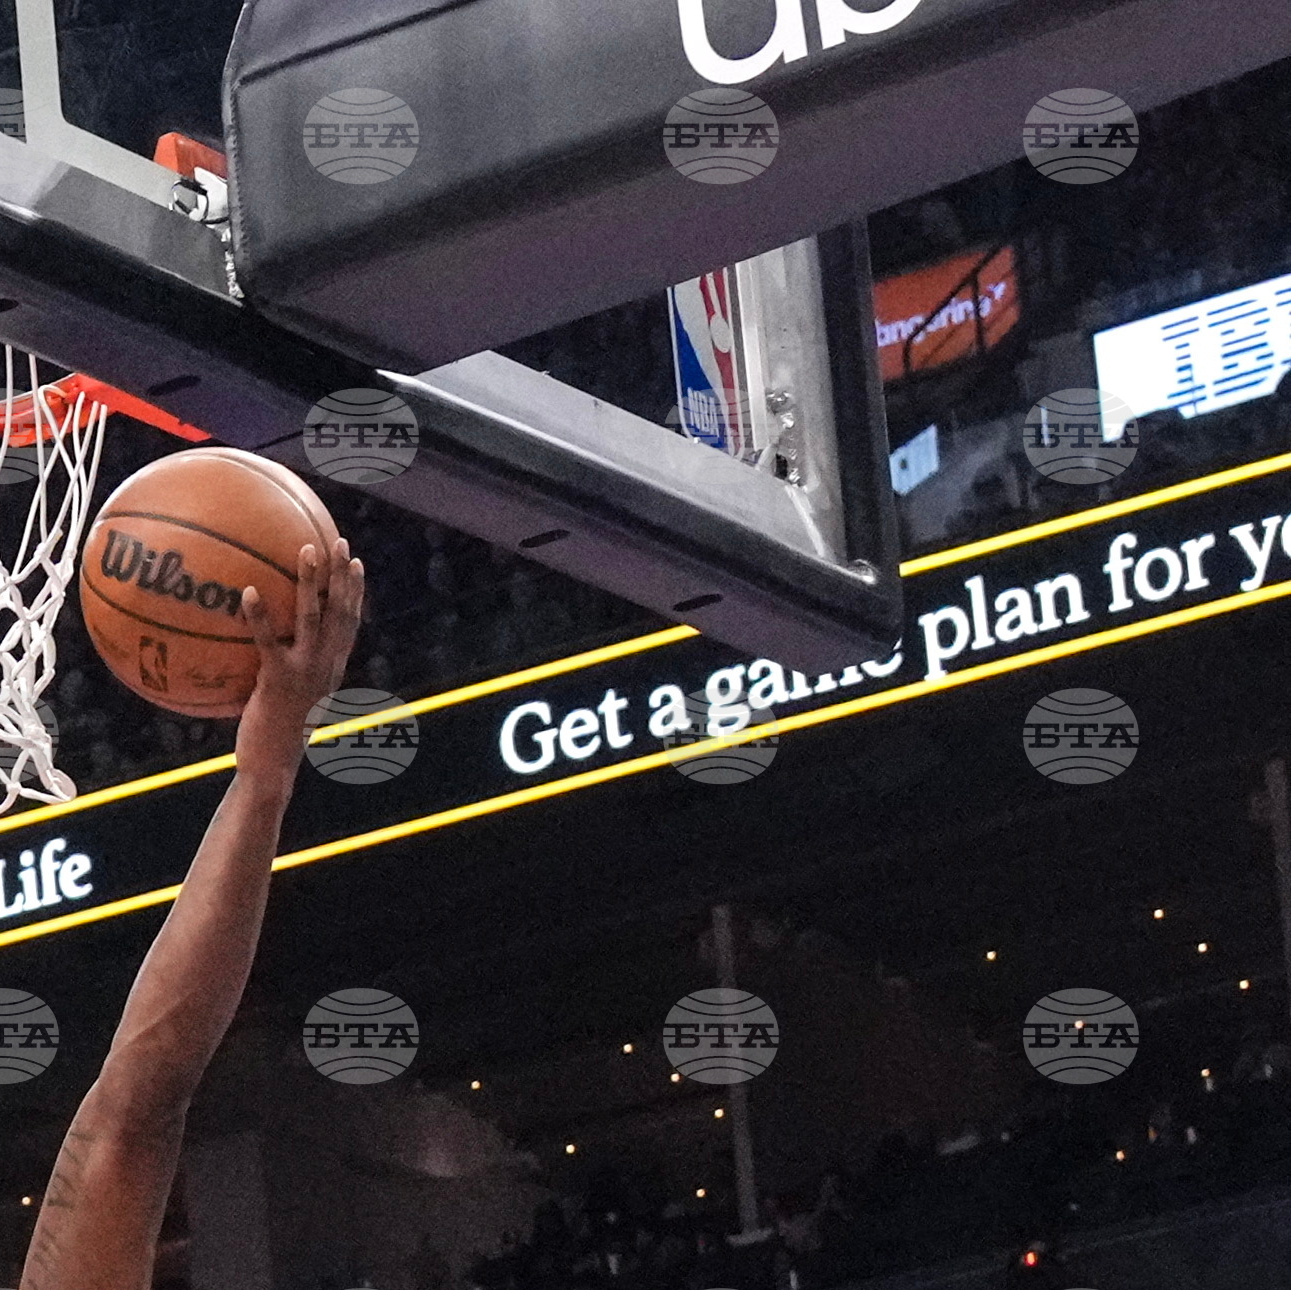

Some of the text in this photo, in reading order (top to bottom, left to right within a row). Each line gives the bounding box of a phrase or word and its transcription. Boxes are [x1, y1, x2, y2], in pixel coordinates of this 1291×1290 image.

[499, 687, 634, 775] Get
[647, 683, 691, 738] a
[918, 572, 1090, 681] plan
[1102, 531, 1216, 613] for
[1228, 511, 1291, 593] y
